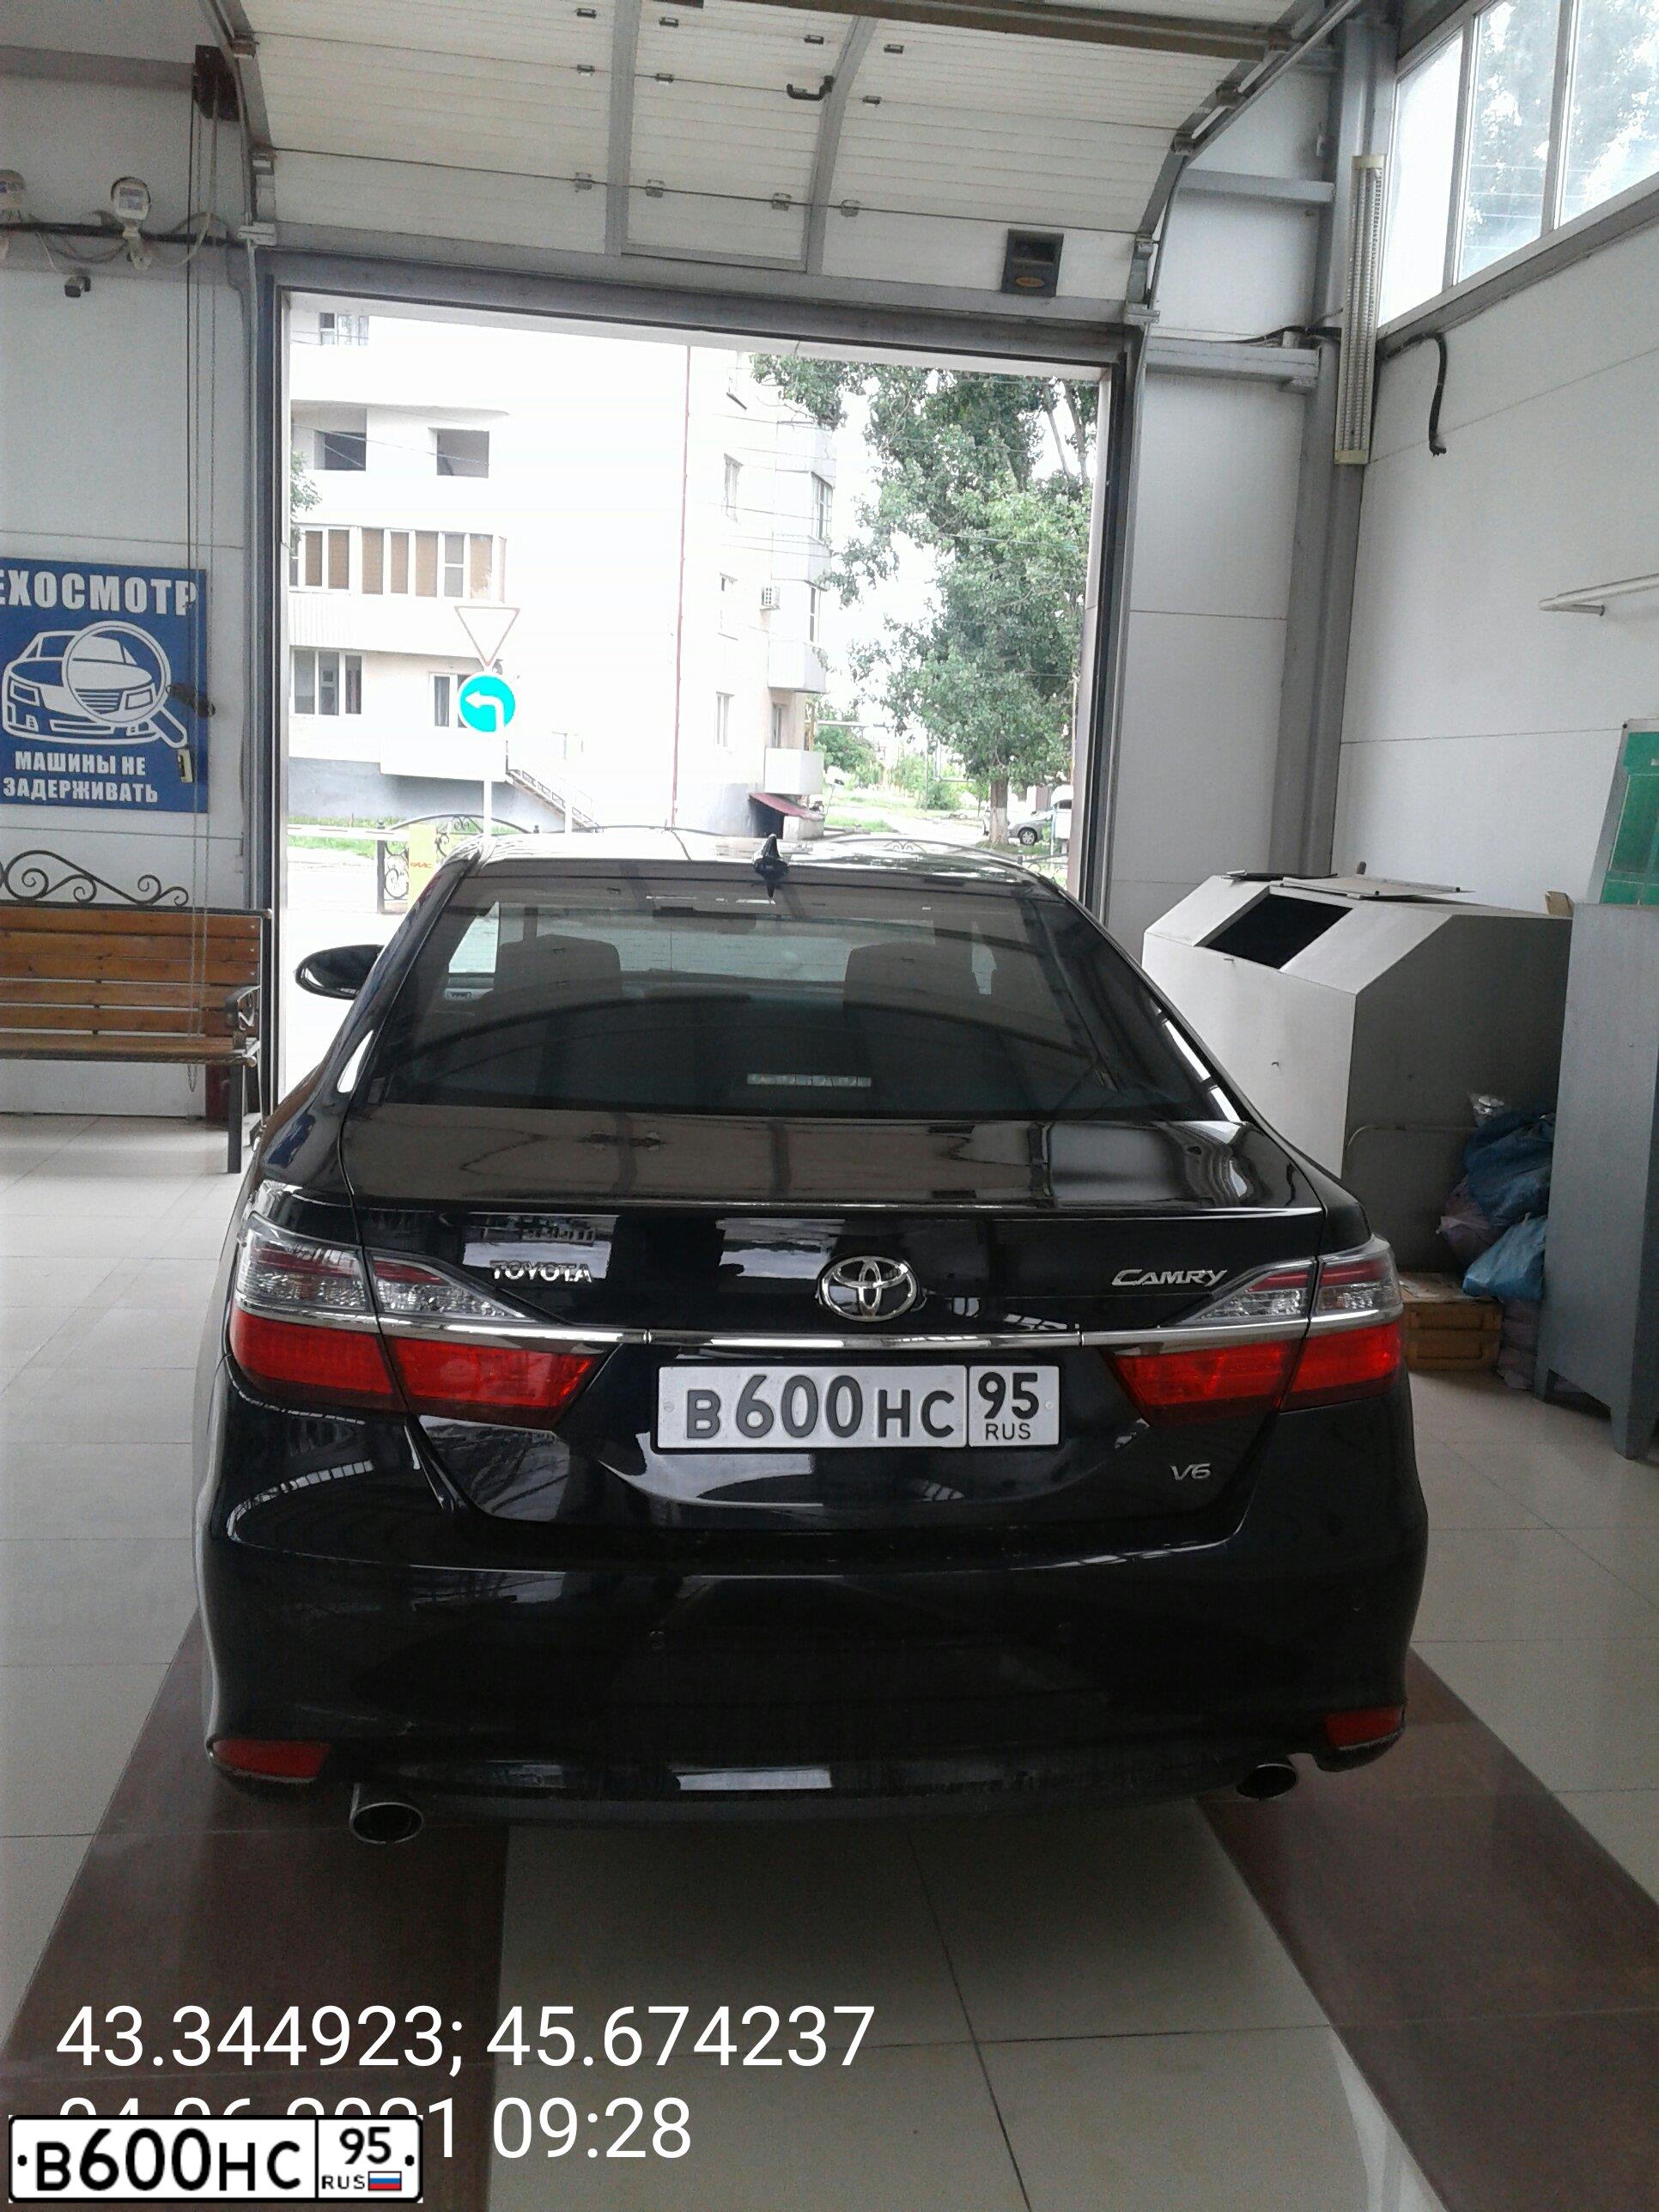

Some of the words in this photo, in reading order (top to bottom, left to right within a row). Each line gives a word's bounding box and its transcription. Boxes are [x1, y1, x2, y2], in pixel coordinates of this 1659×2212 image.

[0, 568, 197, 616] ХОСМОТР
[15, 750, 115, 774] МАШИНЫ
[121, 756, 146, 775] НЕ
[3, 776, 158, 803] ЗАДЕРЖИВАТЬ
[490, 1261, 592, 1283] TOYOTA
[977, 1371, 1040, 1420] 95
[985, 1424, 1030, 1441] RUS
[1170, 1462, 1211, 1480] V6
